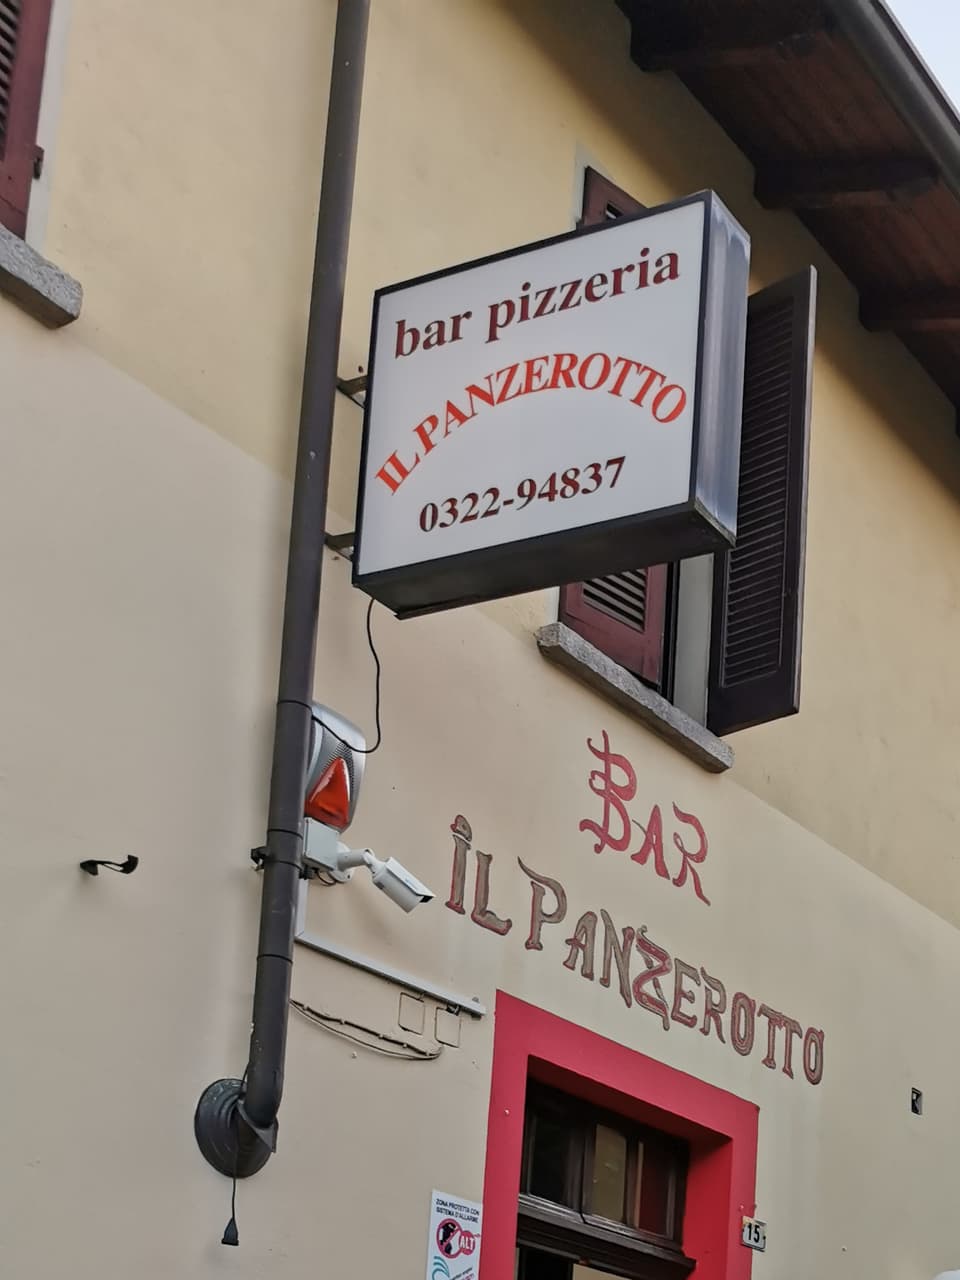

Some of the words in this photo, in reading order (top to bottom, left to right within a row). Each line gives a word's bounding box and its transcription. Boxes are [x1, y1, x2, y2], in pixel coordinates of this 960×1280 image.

[394, 309, 473, 359] bar
[485, 247, 681, 344] pizzeria
[374, 450, 422, 496] IL
[413, 352, 688, 456] PANZEROTTO
[419, 455, 627, 533] 0322-94837
[578, 729, 712, 907] BAR
[445, 814, 513, 936] IL
[517, 856, 825, 1086] PANZEROTTO
[459, 1235, 475, 1251] ALT
[747, 1222, 761, 1243] 15
